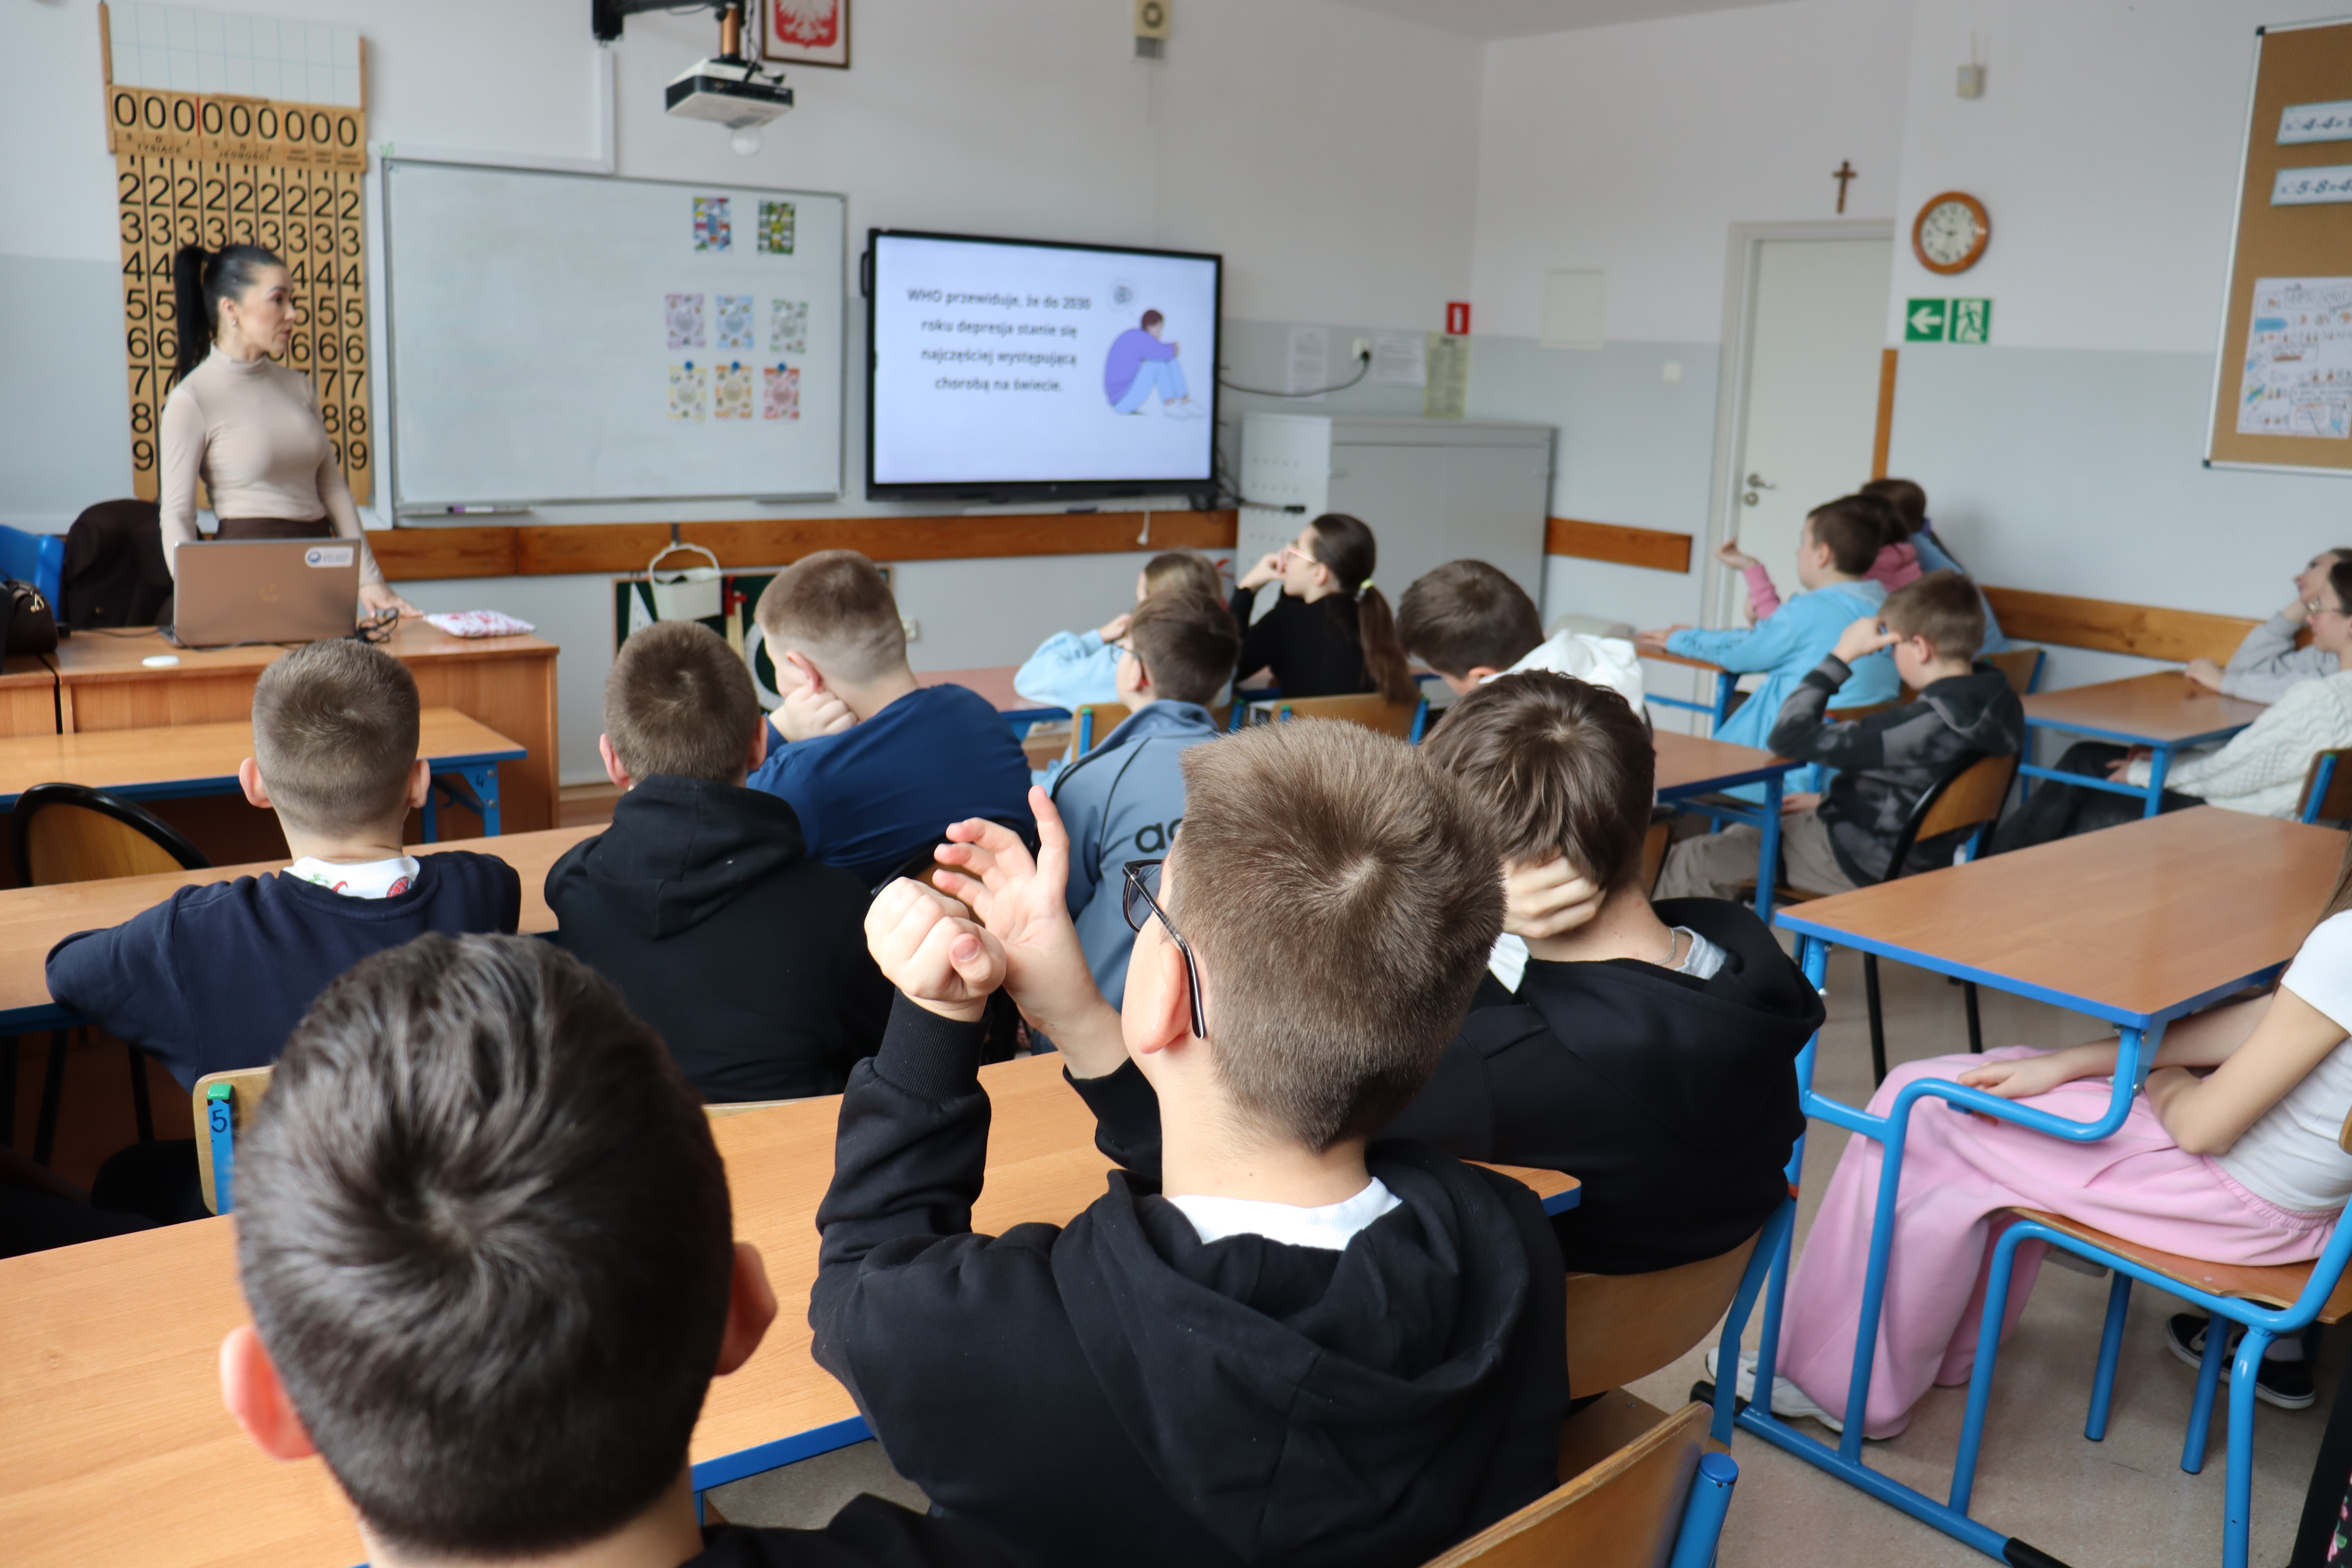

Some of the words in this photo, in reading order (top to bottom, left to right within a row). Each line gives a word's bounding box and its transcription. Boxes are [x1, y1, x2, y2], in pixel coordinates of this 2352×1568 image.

[114, 93, 136, 126] 0
[144, 96, 166, 129] 0
[174, 100, 195, 132] 0
[202, 102, 223, 134] 0
[230, 105, 250, 136] 0
[258, 108, 278, 139] 0
[285, 111, 304, 142] 0
[311, 113, 330, 144] 0
[338, 116, 356, 147] 0
[120, 172, 141, 205] 2
[149, 176, 170, 207] 2
[178, 178, 198, 209] 2
[206, 180, 226, 211] 2
[234, 182, 254, 212] 2
[261, 184, 281, 214] 2
[288, 186, 307, 216] 2
[314, 187, 333, 218] 2
[341, 191, 359, 220] 2
[122, 212, 143, 244] 3
[151, 213, 172, 245] 3
[289, 222, 308, 254] 3
[315, 225, 334, 254] 3
[342, 226, 360, 256] 3
[123, 251, 145, 282] 4
[316, 261, 334, 289] 4
[343, 263, 363, 292] 4
[126, 289, 147, 320] 5
[318, 297, 337, 327] 5
[345, 299, 363, 328] 5
[907, 289, 942, 303] WHO
[946, 292, 1022, 310] przewiduje,
[1043, 294, 1059, 309] do
[1063, 296, 1092, 310] 2030
[127, 327, 149, 358] 6
[291, 333, 310, 362] 6
[319, 332, 338, 362] 6
[346, 335, 364, 364] 6
[922, 319, 954, 332] roku
[957, 319, 1014, 338] depresja
[1018, 323, 1057, 337] stanie
[1060, 325, 1077, 340] się
[922, 348, 994, 366] najczęściej
[997, 350, 1077, 367] występującą
[129, 365, 150, 396] 7
[319, 369, 338, 397] 7
[346, 370, 365, 399] 7
[935, 376, 991, 394] chorobą
[994, 380, 1010, 391] na
[1014, 378, 1063, 392] świecie.
[132, 403, 153, 434] 8
[348, 405, 366, 435] 8
[132, 440, 154, 471] 9
[349, 441, 368, 470] 9
[212, 1109, 228, 1133] 5
